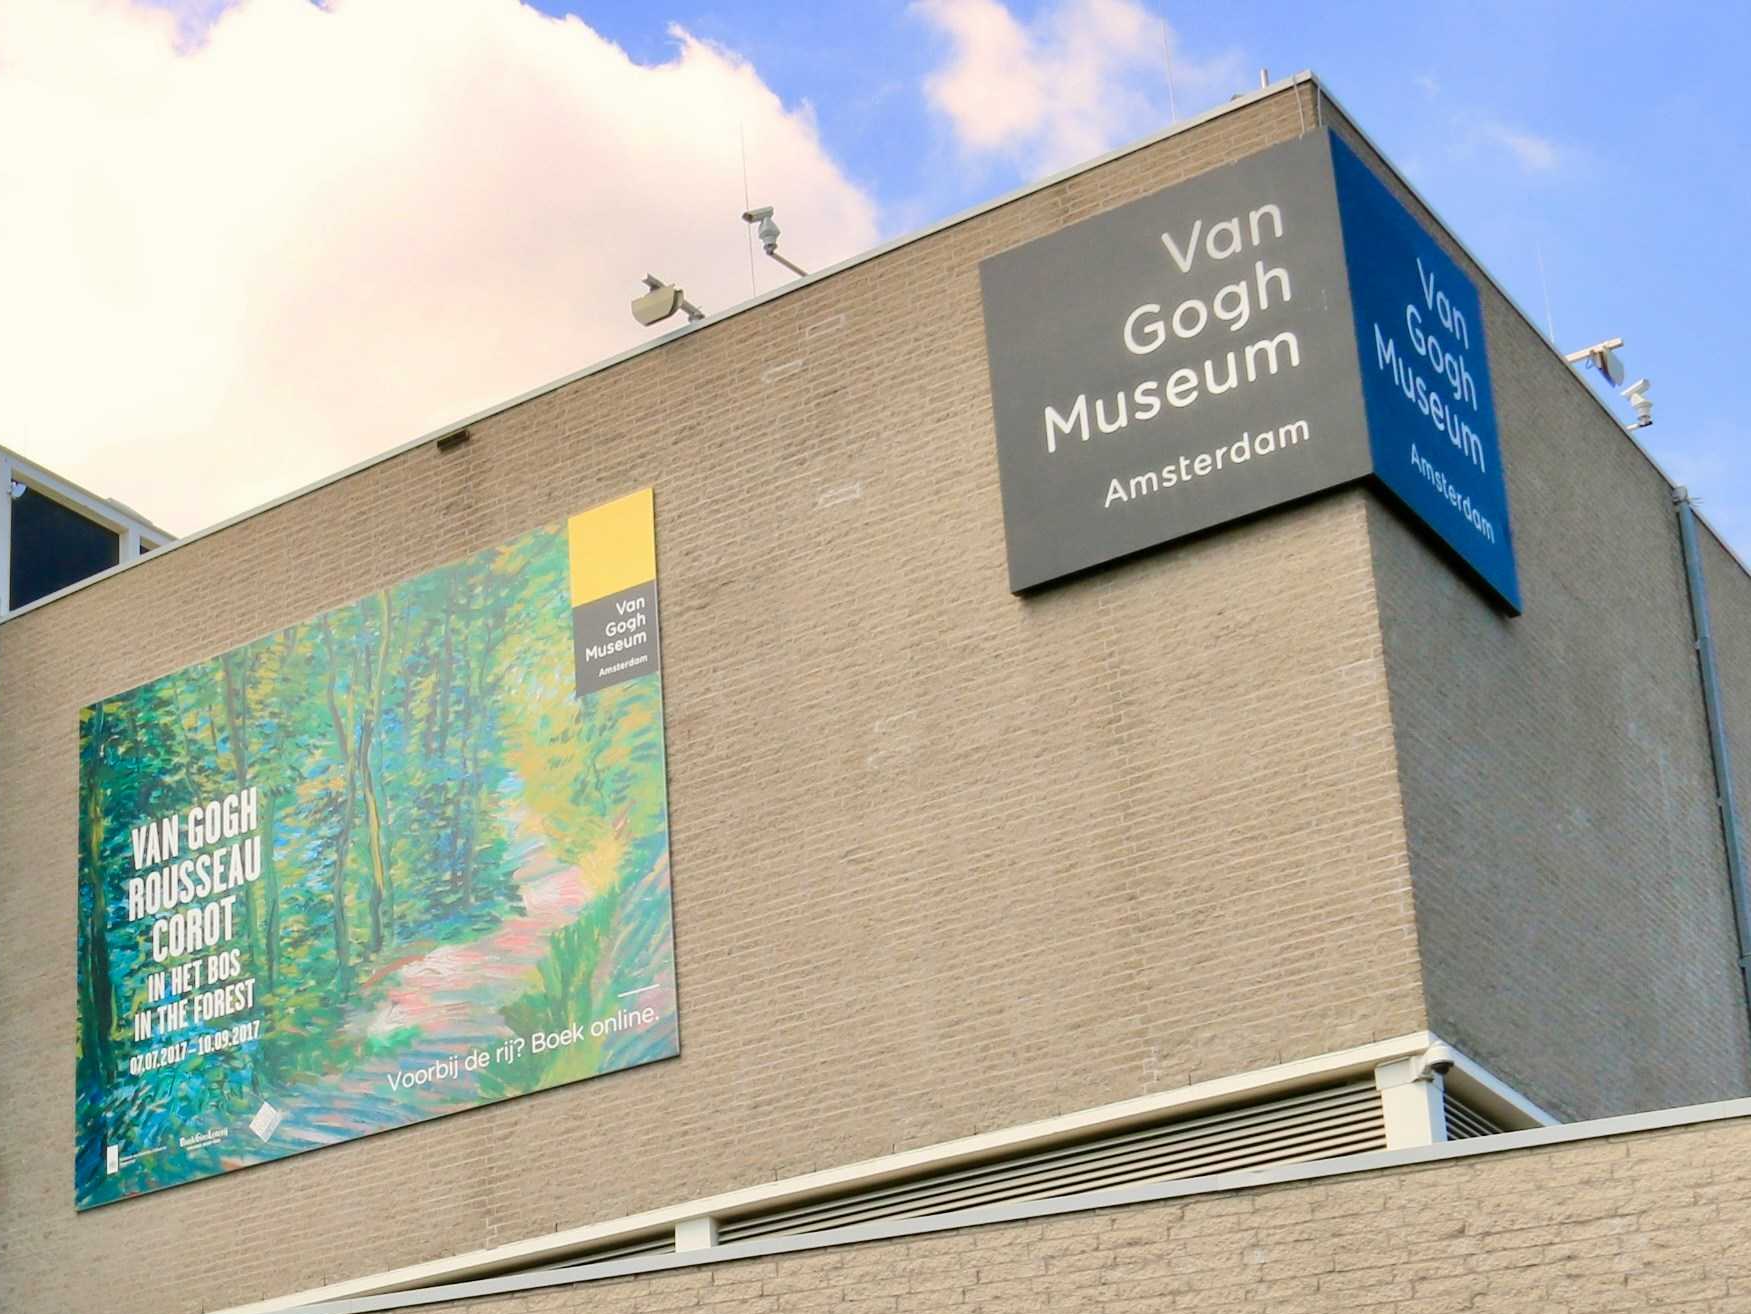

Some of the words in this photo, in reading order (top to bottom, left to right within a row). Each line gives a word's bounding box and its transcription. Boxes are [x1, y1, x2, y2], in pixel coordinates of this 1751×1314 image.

[1161, 203, 1284, 275] Van
[1124, 260, 1292, 355] Gogh
[1416, 257, 1468, 349] Van
[1044, 330, 1300, 453] Museum
[1406, 304, 1478, 411] Gogh
[1374, 323, 1485, 473] Museum
[1103, 418, 1309, 508] Amsterdam
[1410, 442, 1496, 543] Amsterdam
[605, 613, 646, 637] Gogh
[615, 597, 645, 615] Van
[585, 631, 647, 662] Museum
[598, 655, 648, 677] Amsterdam
[131, 812, 179, 870] VAN
[187, 787, 257, 848] GOGH
[128, 846, 262, 922] ROUSSEAU
[151, 897, 236, 963] COROT
[134, 1010, 152, 1042] IN
[156, 1000, 189, 1035] THE
[193, 978, 256, 1026] FOREST
[148, 972, 165, 1003] IN
[170, 961, 203, 995] HET
[207, 949, 241, 984] BOS
[387, 1055, 458, 1091] Voorbij
[464, 1050, 490, 1072] de
[496, 1038, 525, 1065] rij?
[531, 1023, 584, 1054] Boek
[590, 1006, 660, 1037] online.
